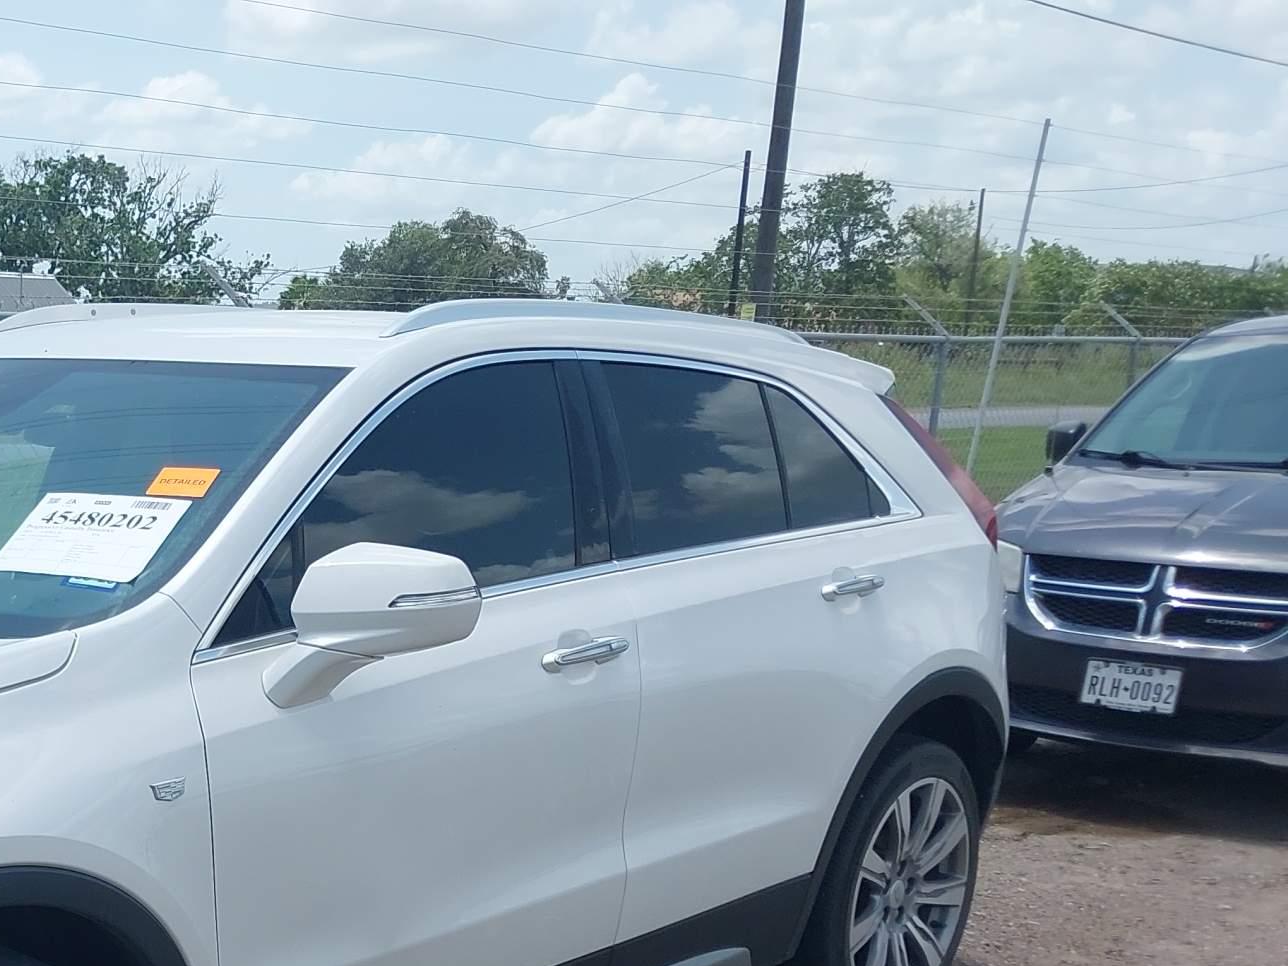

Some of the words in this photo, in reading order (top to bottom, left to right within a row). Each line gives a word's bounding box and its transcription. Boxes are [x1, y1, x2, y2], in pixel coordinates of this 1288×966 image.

[159, 478, 207, 486] DETAILED
[41, 510, 158, 531] 45480202
[1117, 665, 1153, 677] TEXAS
